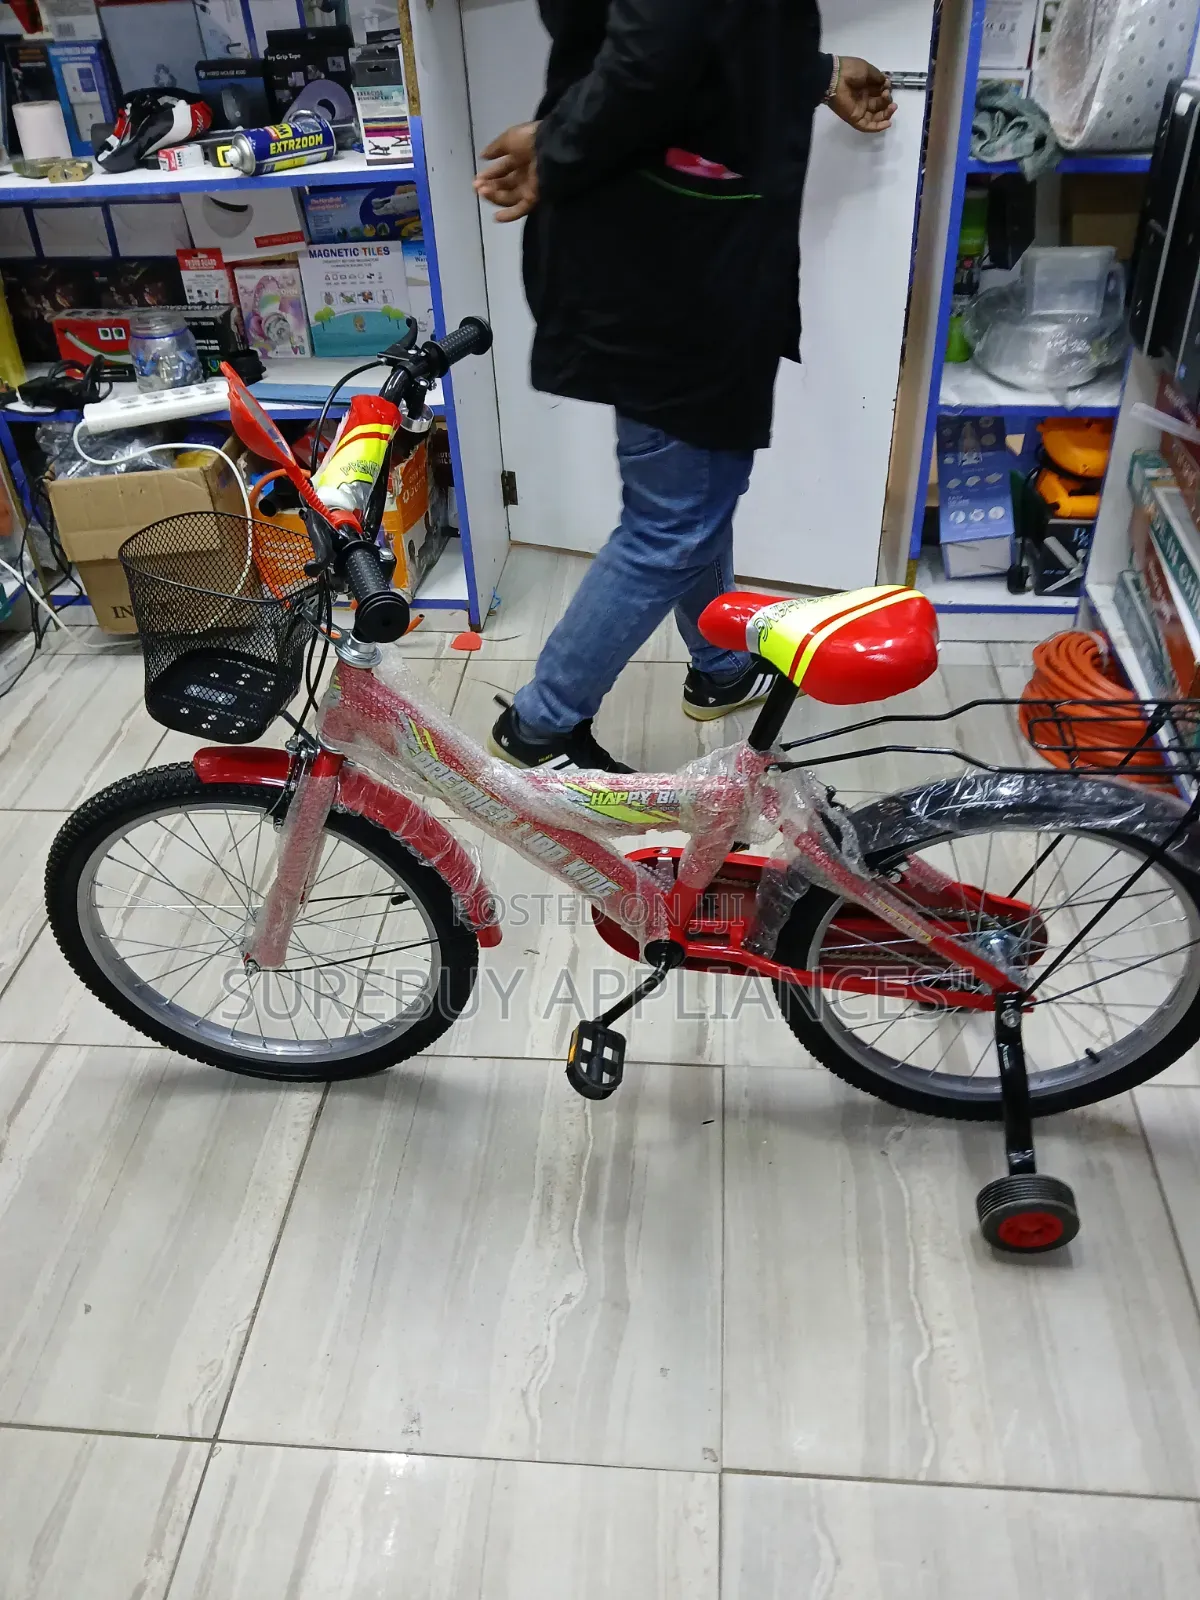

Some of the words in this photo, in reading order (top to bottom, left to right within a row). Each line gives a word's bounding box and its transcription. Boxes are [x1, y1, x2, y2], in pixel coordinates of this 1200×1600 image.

[269, 133, 323, 154] EXTRZOOM
[308, 248, 360, 259] MAGNETIC
[362, 246, 391, 256] TILES
[590, 790, 652, 806] HAPPY
